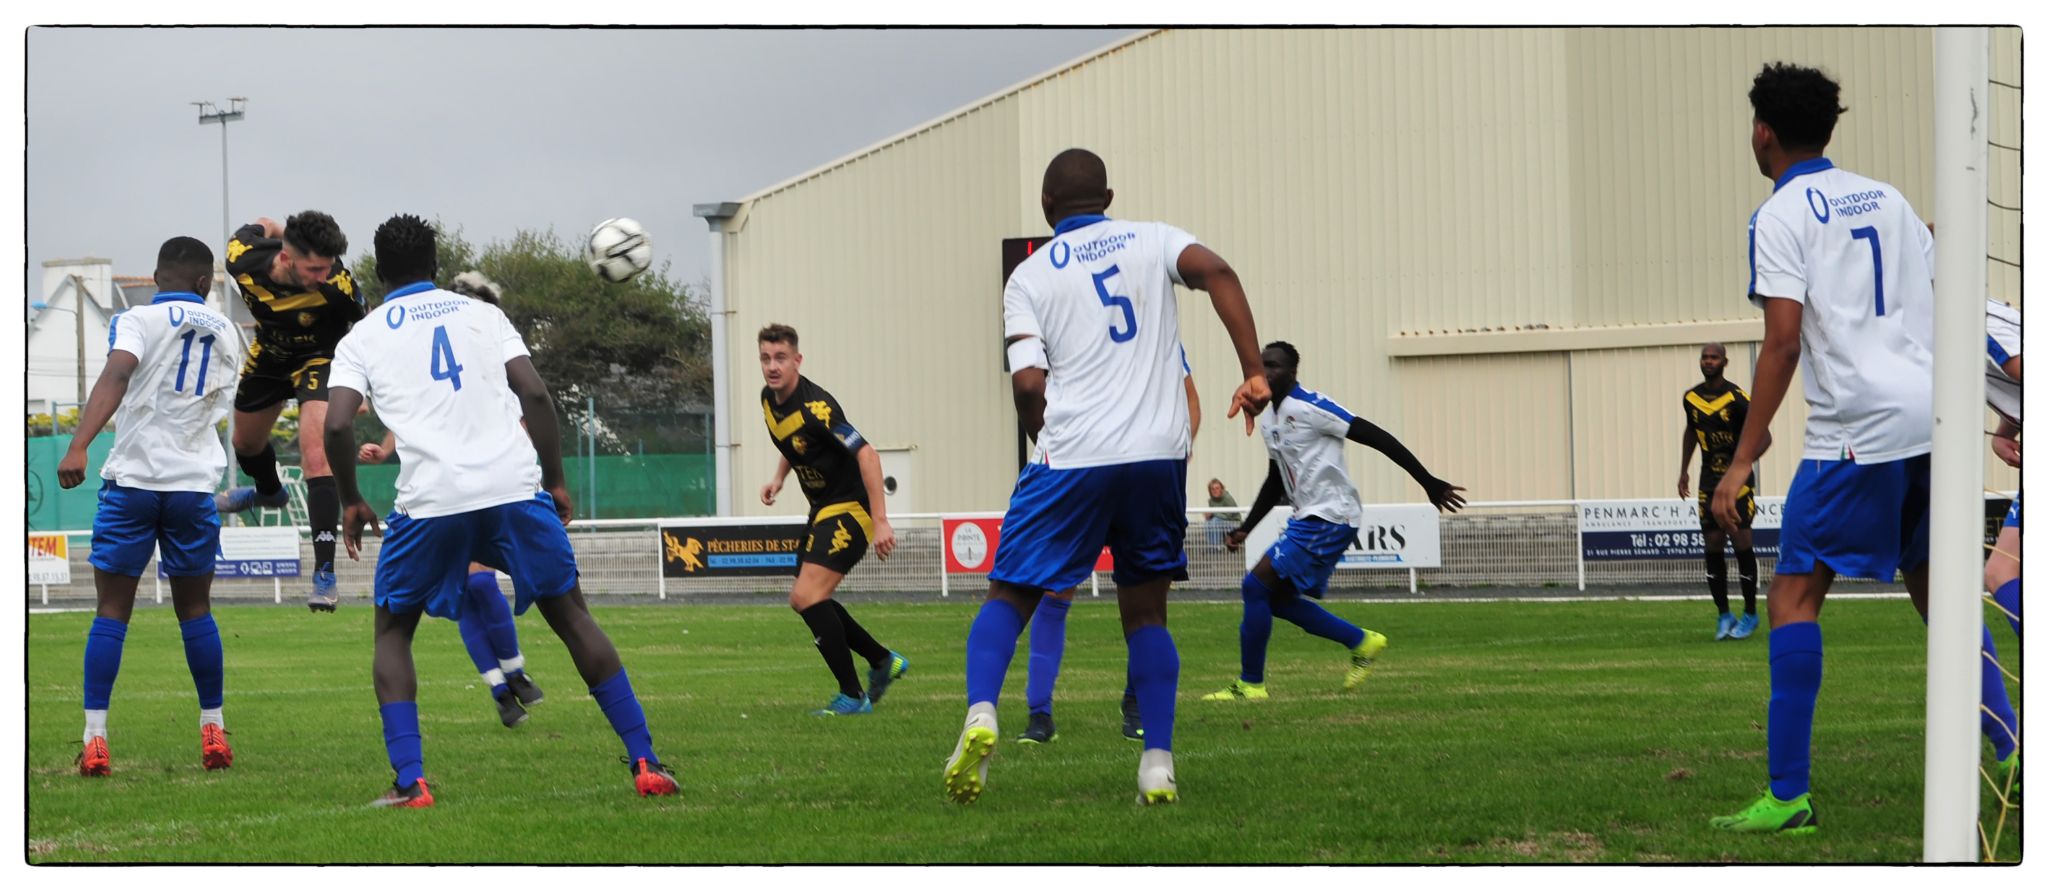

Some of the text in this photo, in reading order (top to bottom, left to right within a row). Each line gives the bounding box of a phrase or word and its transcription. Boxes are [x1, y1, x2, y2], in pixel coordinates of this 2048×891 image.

[1829, 190, 1886, 207] OUTDOOR
[1835, 201, 1881, 217] INDOOR
[1073, 232, 1136, 253] OUTDOOR
[1077, 243, 1126, 263] INDOOR
[1850, 225, 1885, 317] 7
[409, 299, 470, 313] OUTDOOR
[1092, 264, 1137, 343] 5
[411, 306, 460, 321] INDOOR
[175, 328, 216, 396] 11
[430, 325, 464, 392] 4
[308, 371, 320, 390] 5
[1585, 506, 1680, 519] PENMARC'H
[28, 537, 57, 556] TEM
[766, 539, 780, 551] DE
[1347, 525, 1406, 550] ARS
[1630, 533, 1647, 547] Tél
[1655, 533, 1670, 547] 02
[1672, 533, 1689, 547] 98
